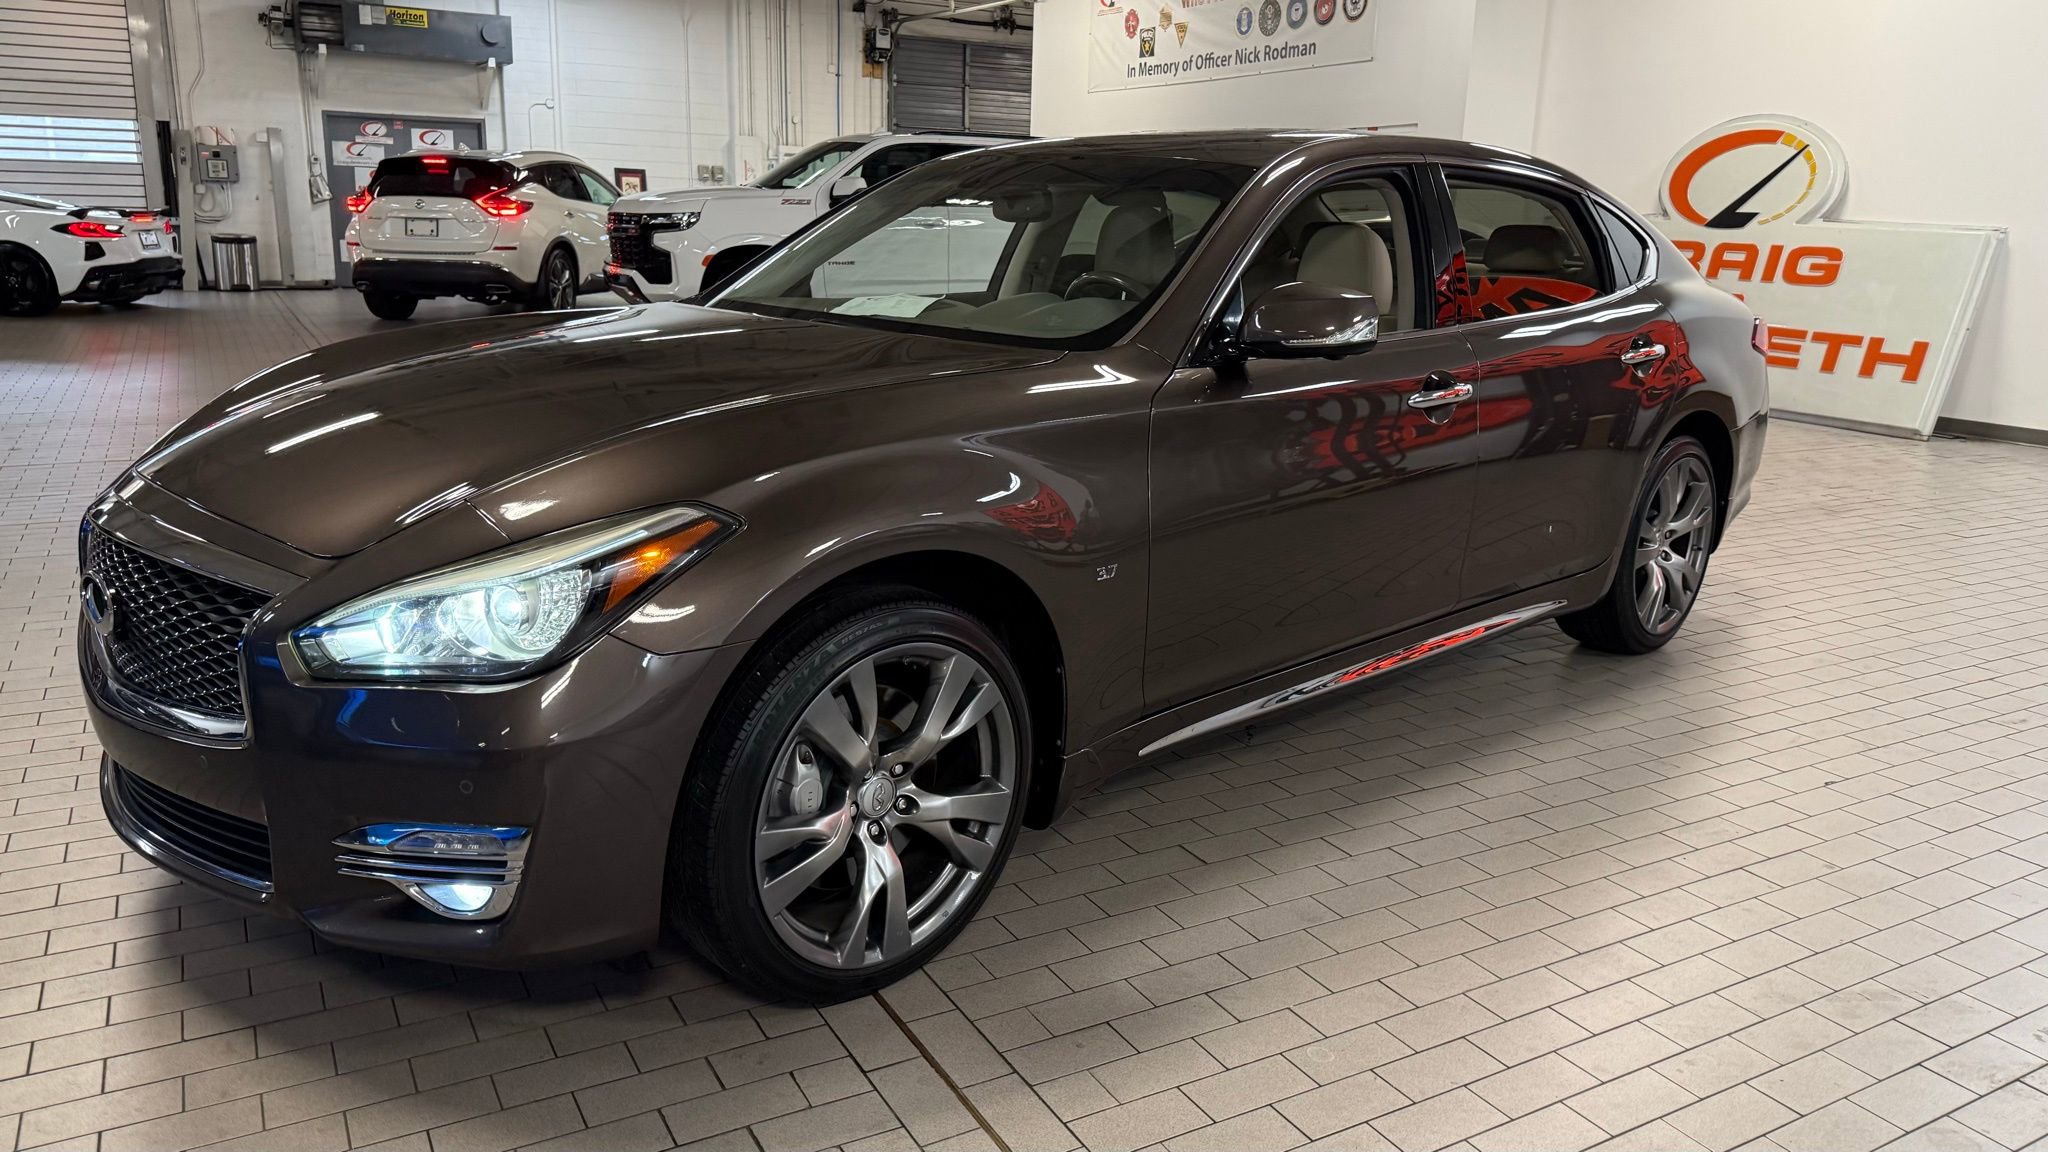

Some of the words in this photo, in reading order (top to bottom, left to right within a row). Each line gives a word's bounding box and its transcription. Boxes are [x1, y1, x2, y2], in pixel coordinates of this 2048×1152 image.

[390, 9, 424, 20] Horizon
[1127, 63, 1136, 78] In
[1139, 60, 1180, 77] Memory
[1182, 55, 1194, 72] of
[1195, 51, 1232, 70] Officer
[1235, 45, 1261, 65] Nick
[1263, 41, 1317, 65] Rodman
